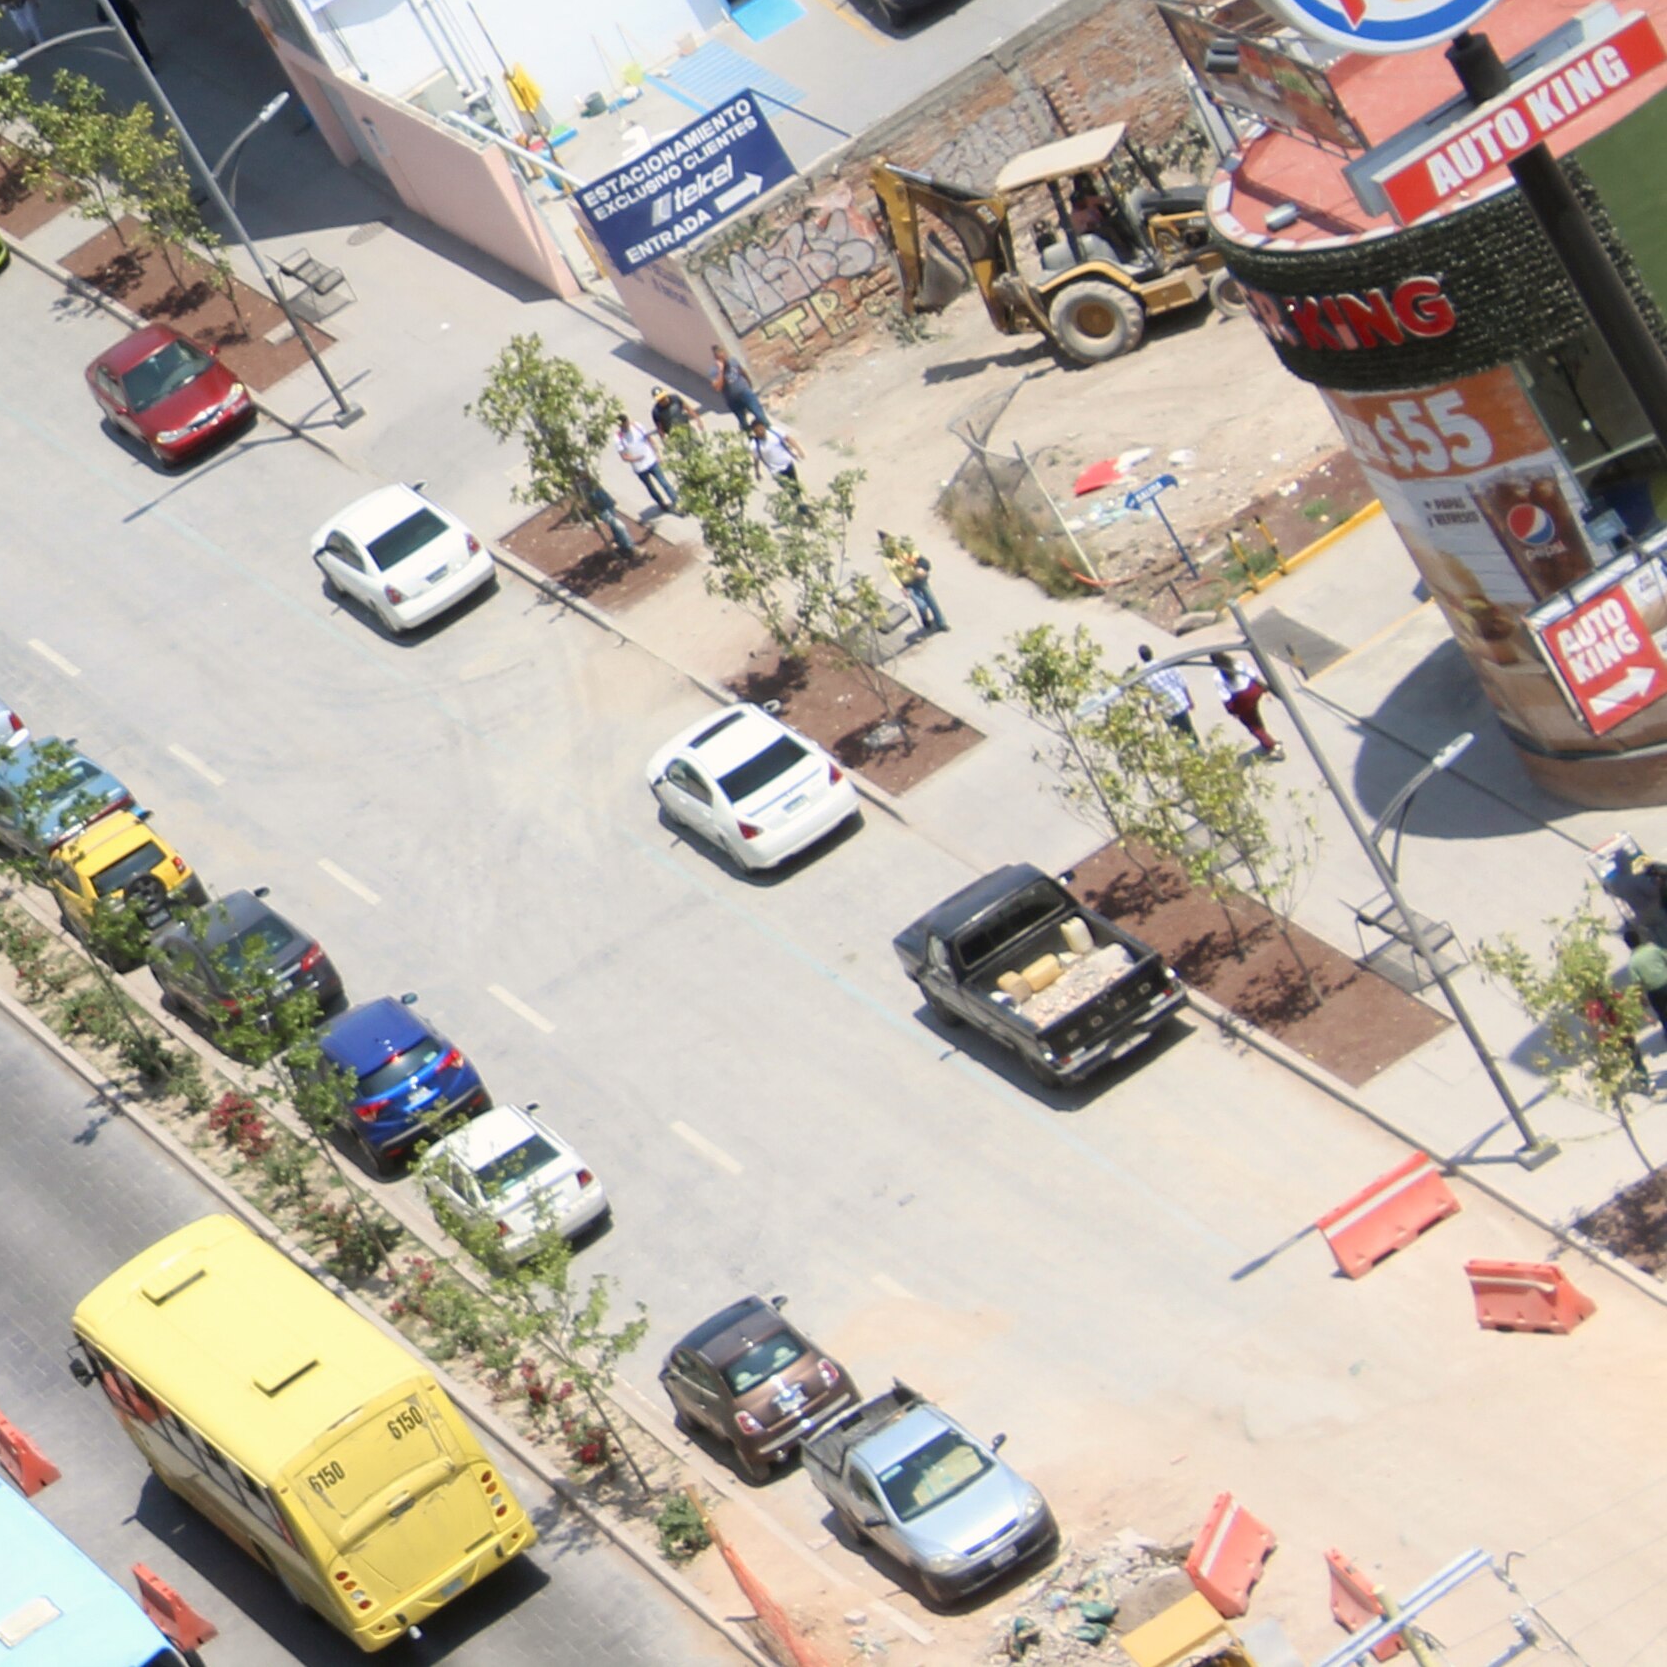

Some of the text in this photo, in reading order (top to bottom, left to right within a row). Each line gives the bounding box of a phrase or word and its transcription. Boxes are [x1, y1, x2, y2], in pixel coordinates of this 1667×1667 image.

[1424, 44, 1631, 198] AUTO KING
[582, 98, 752, 209] ESTACIONAMIENTO
[592, 115, 758, 222] EXCLUSIVO CLIENTES
[673, 153, 734, 213] telcel
[624, 208, 713, 265] ENTRADA
[1281, 275, 1457, 351] KING
[1375, 389, 1494, 474] $55
[1556, 597, 1629, 658] AUTO
[1568, 623, 1642, 685] KING
[387, 1404, 424, 1441] 6150
[307, 1460, 346, 1493] 6150
